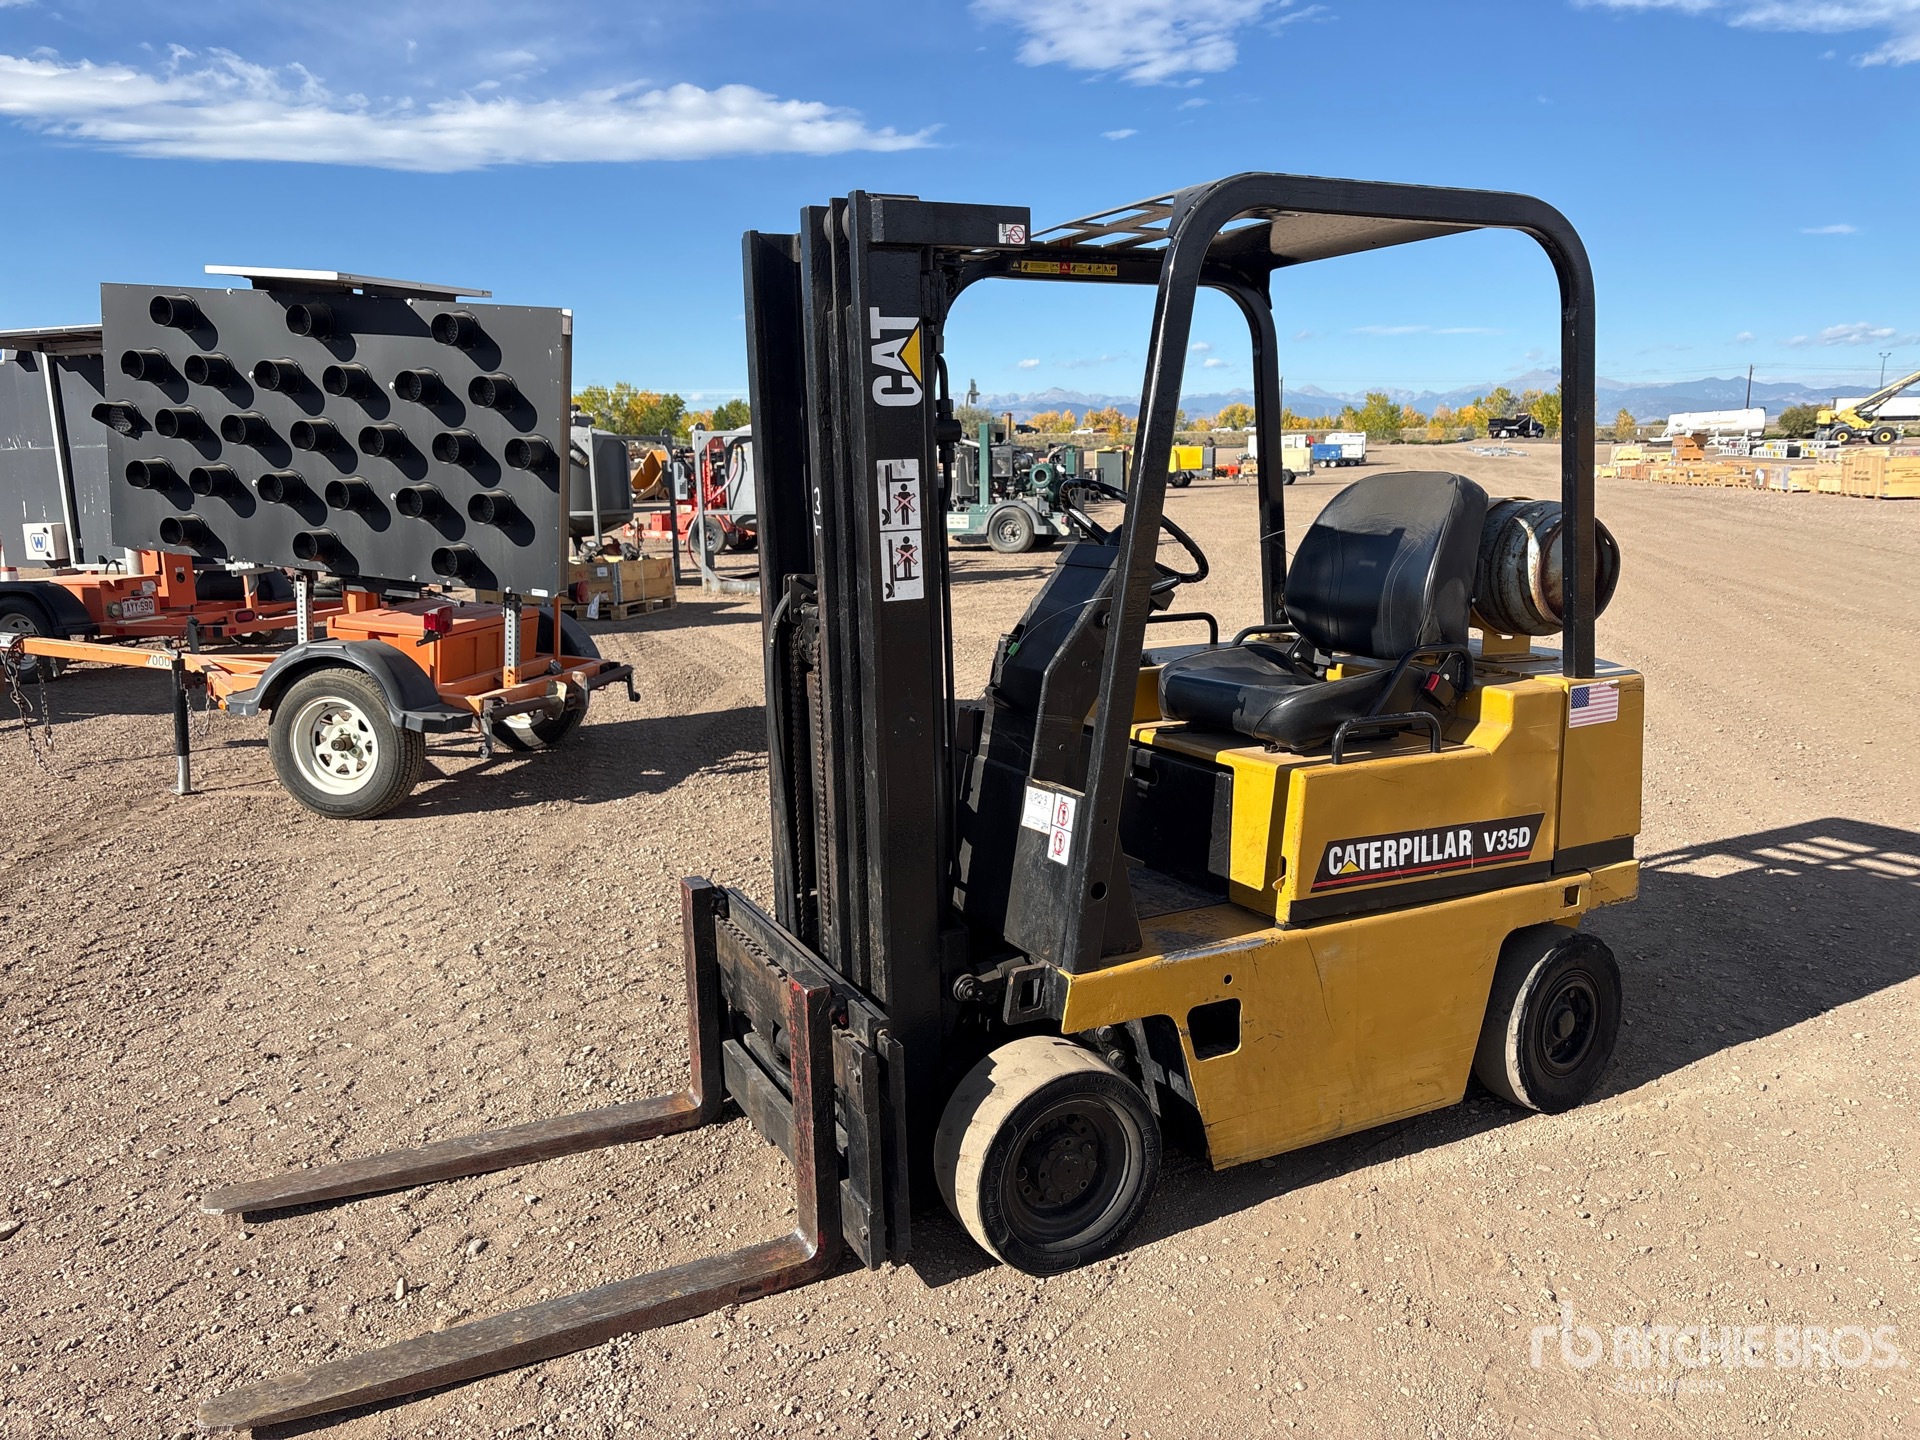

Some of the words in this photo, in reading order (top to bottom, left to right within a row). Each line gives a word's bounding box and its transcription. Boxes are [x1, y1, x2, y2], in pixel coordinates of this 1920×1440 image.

[869, 307, 922, 406] CAT
[1328, 829, 1472, 876] CATERPILLAR
[1483, 826, 1531, 853] V35D
